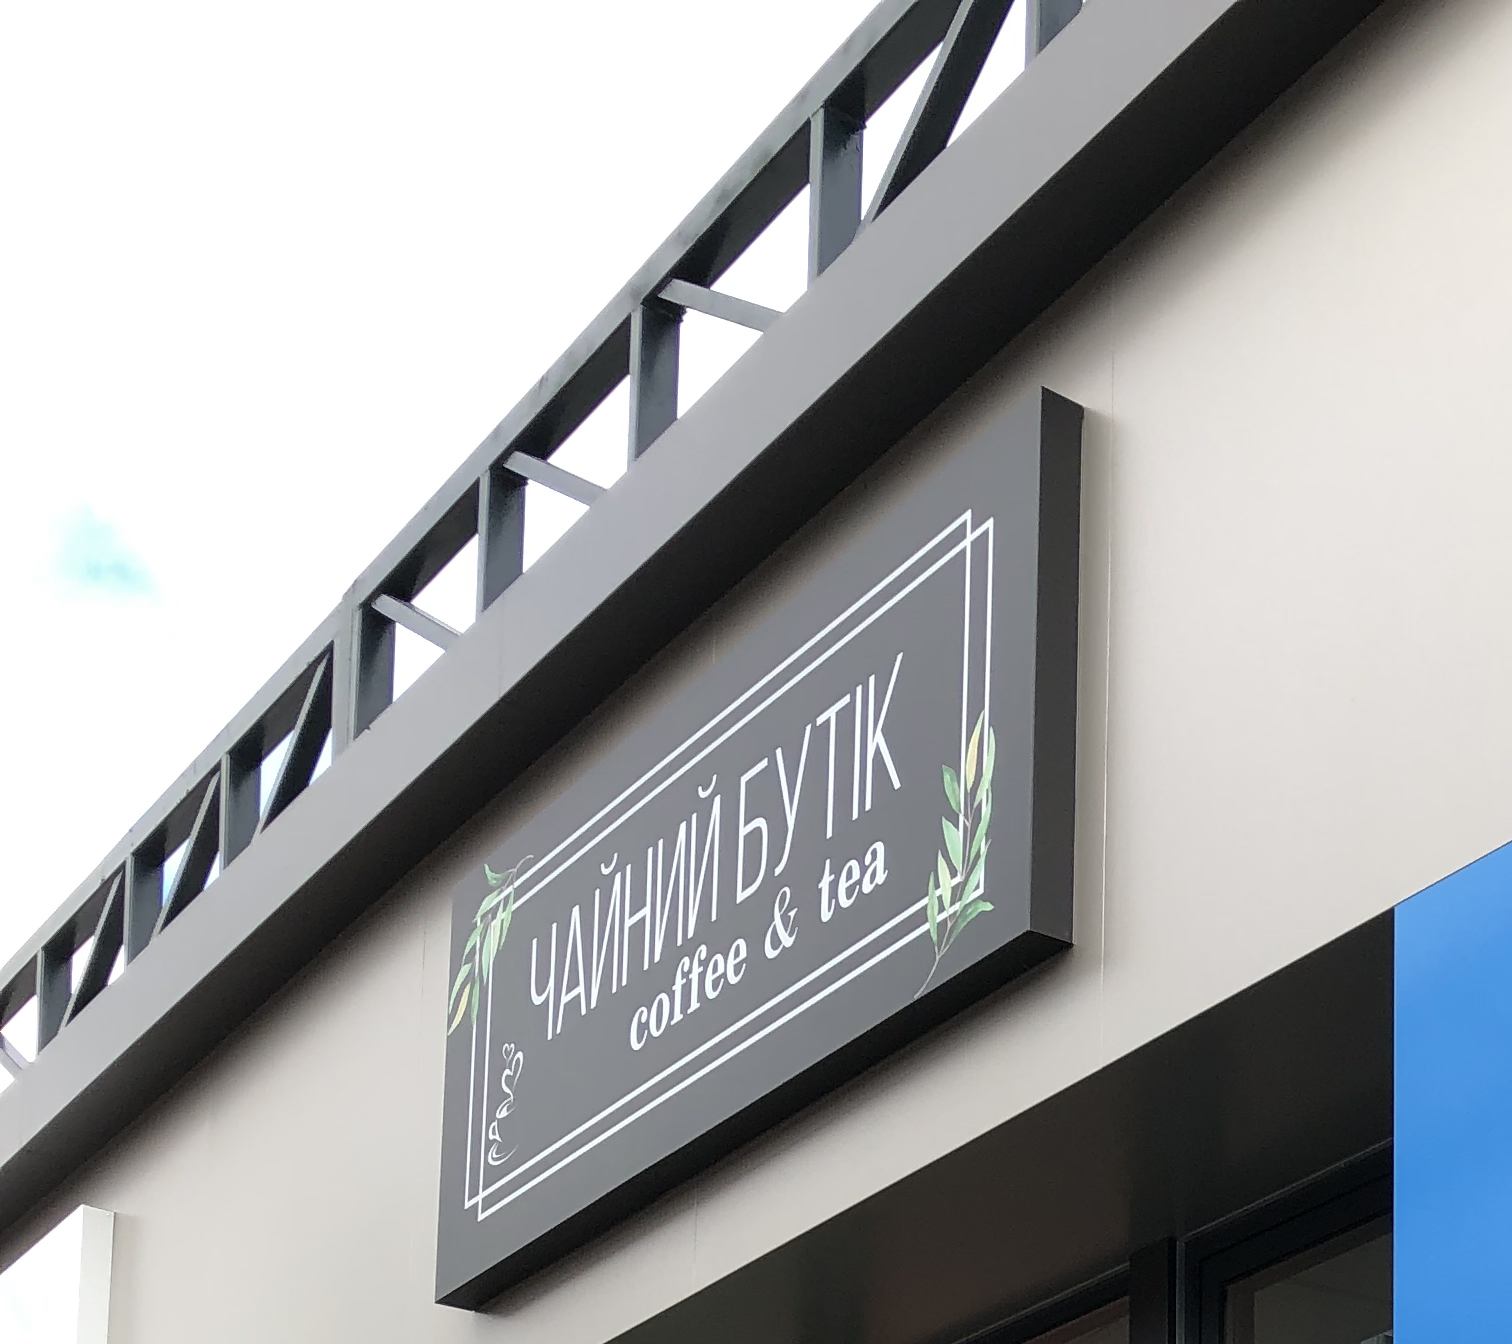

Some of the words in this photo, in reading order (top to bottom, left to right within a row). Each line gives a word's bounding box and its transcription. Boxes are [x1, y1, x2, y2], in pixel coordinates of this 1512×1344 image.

[529, 774, 719, 1040] ЧАЙНИЙ
[736, 652, 902, 904] БУТІК
[629, 938, 746, 1051] coffee
[765, 886, 799, 961] &
[817, 840, 888, 923] tea
